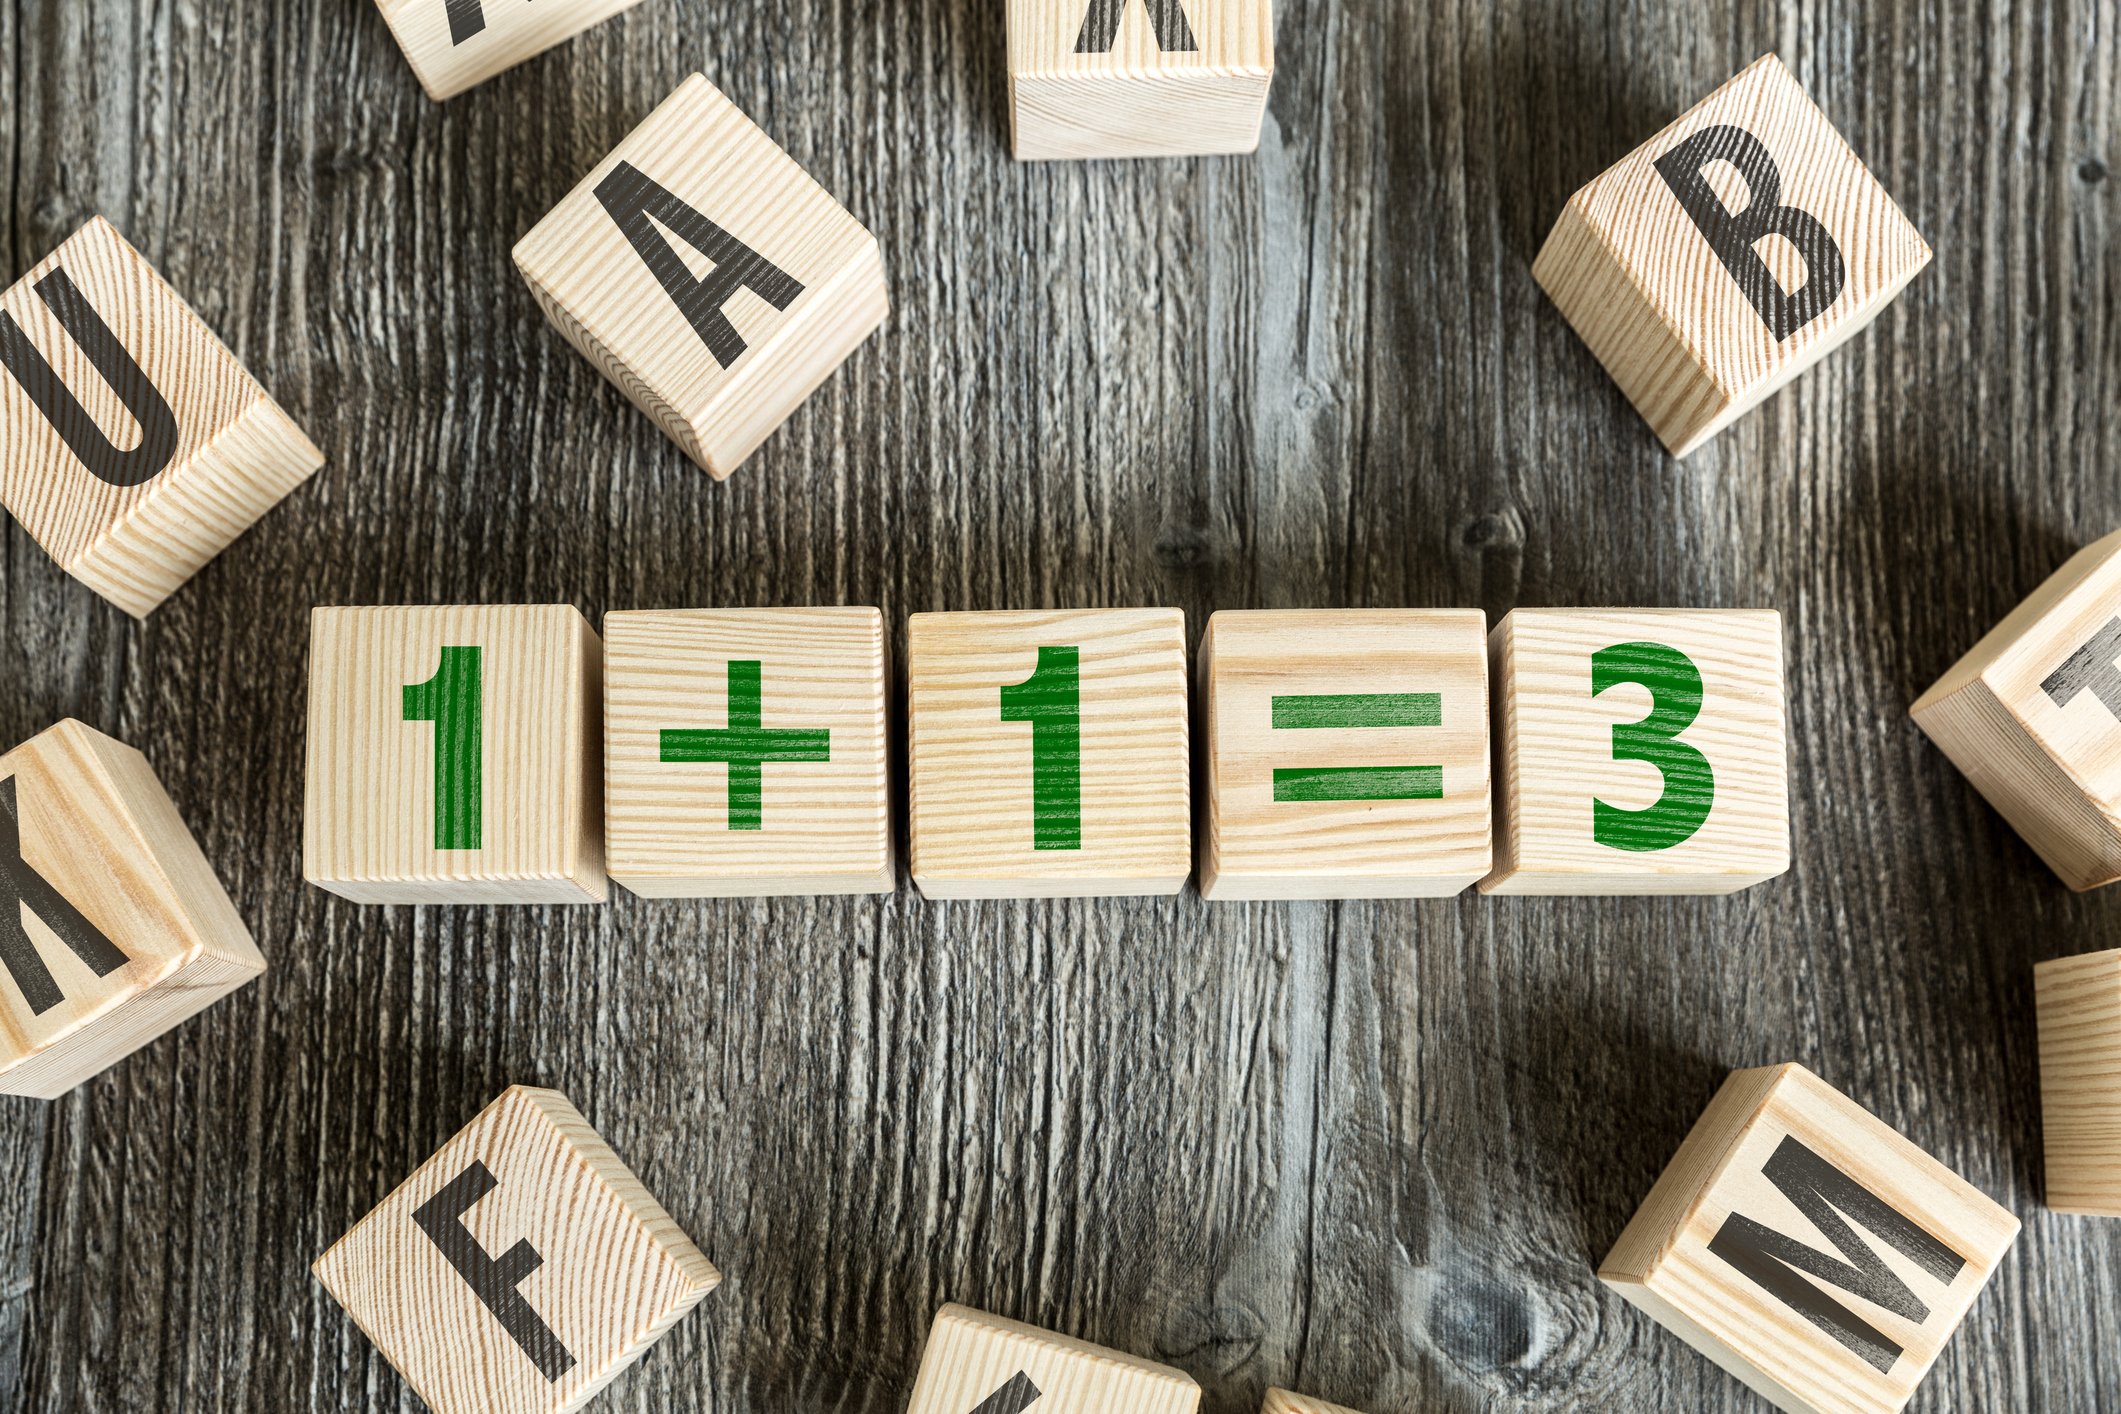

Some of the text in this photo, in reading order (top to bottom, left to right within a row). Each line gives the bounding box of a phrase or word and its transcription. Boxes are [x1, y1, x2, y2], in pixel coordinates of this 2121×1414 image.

[592, 159, 806, 370] A
[1652, 125, 1846, 344] B
[0, 266, 178, 487] U
[1591, 642, 1715, 852] 3
[411, 1159, 577, 1384] F
[1706, 1134, 1967, 1375] M
